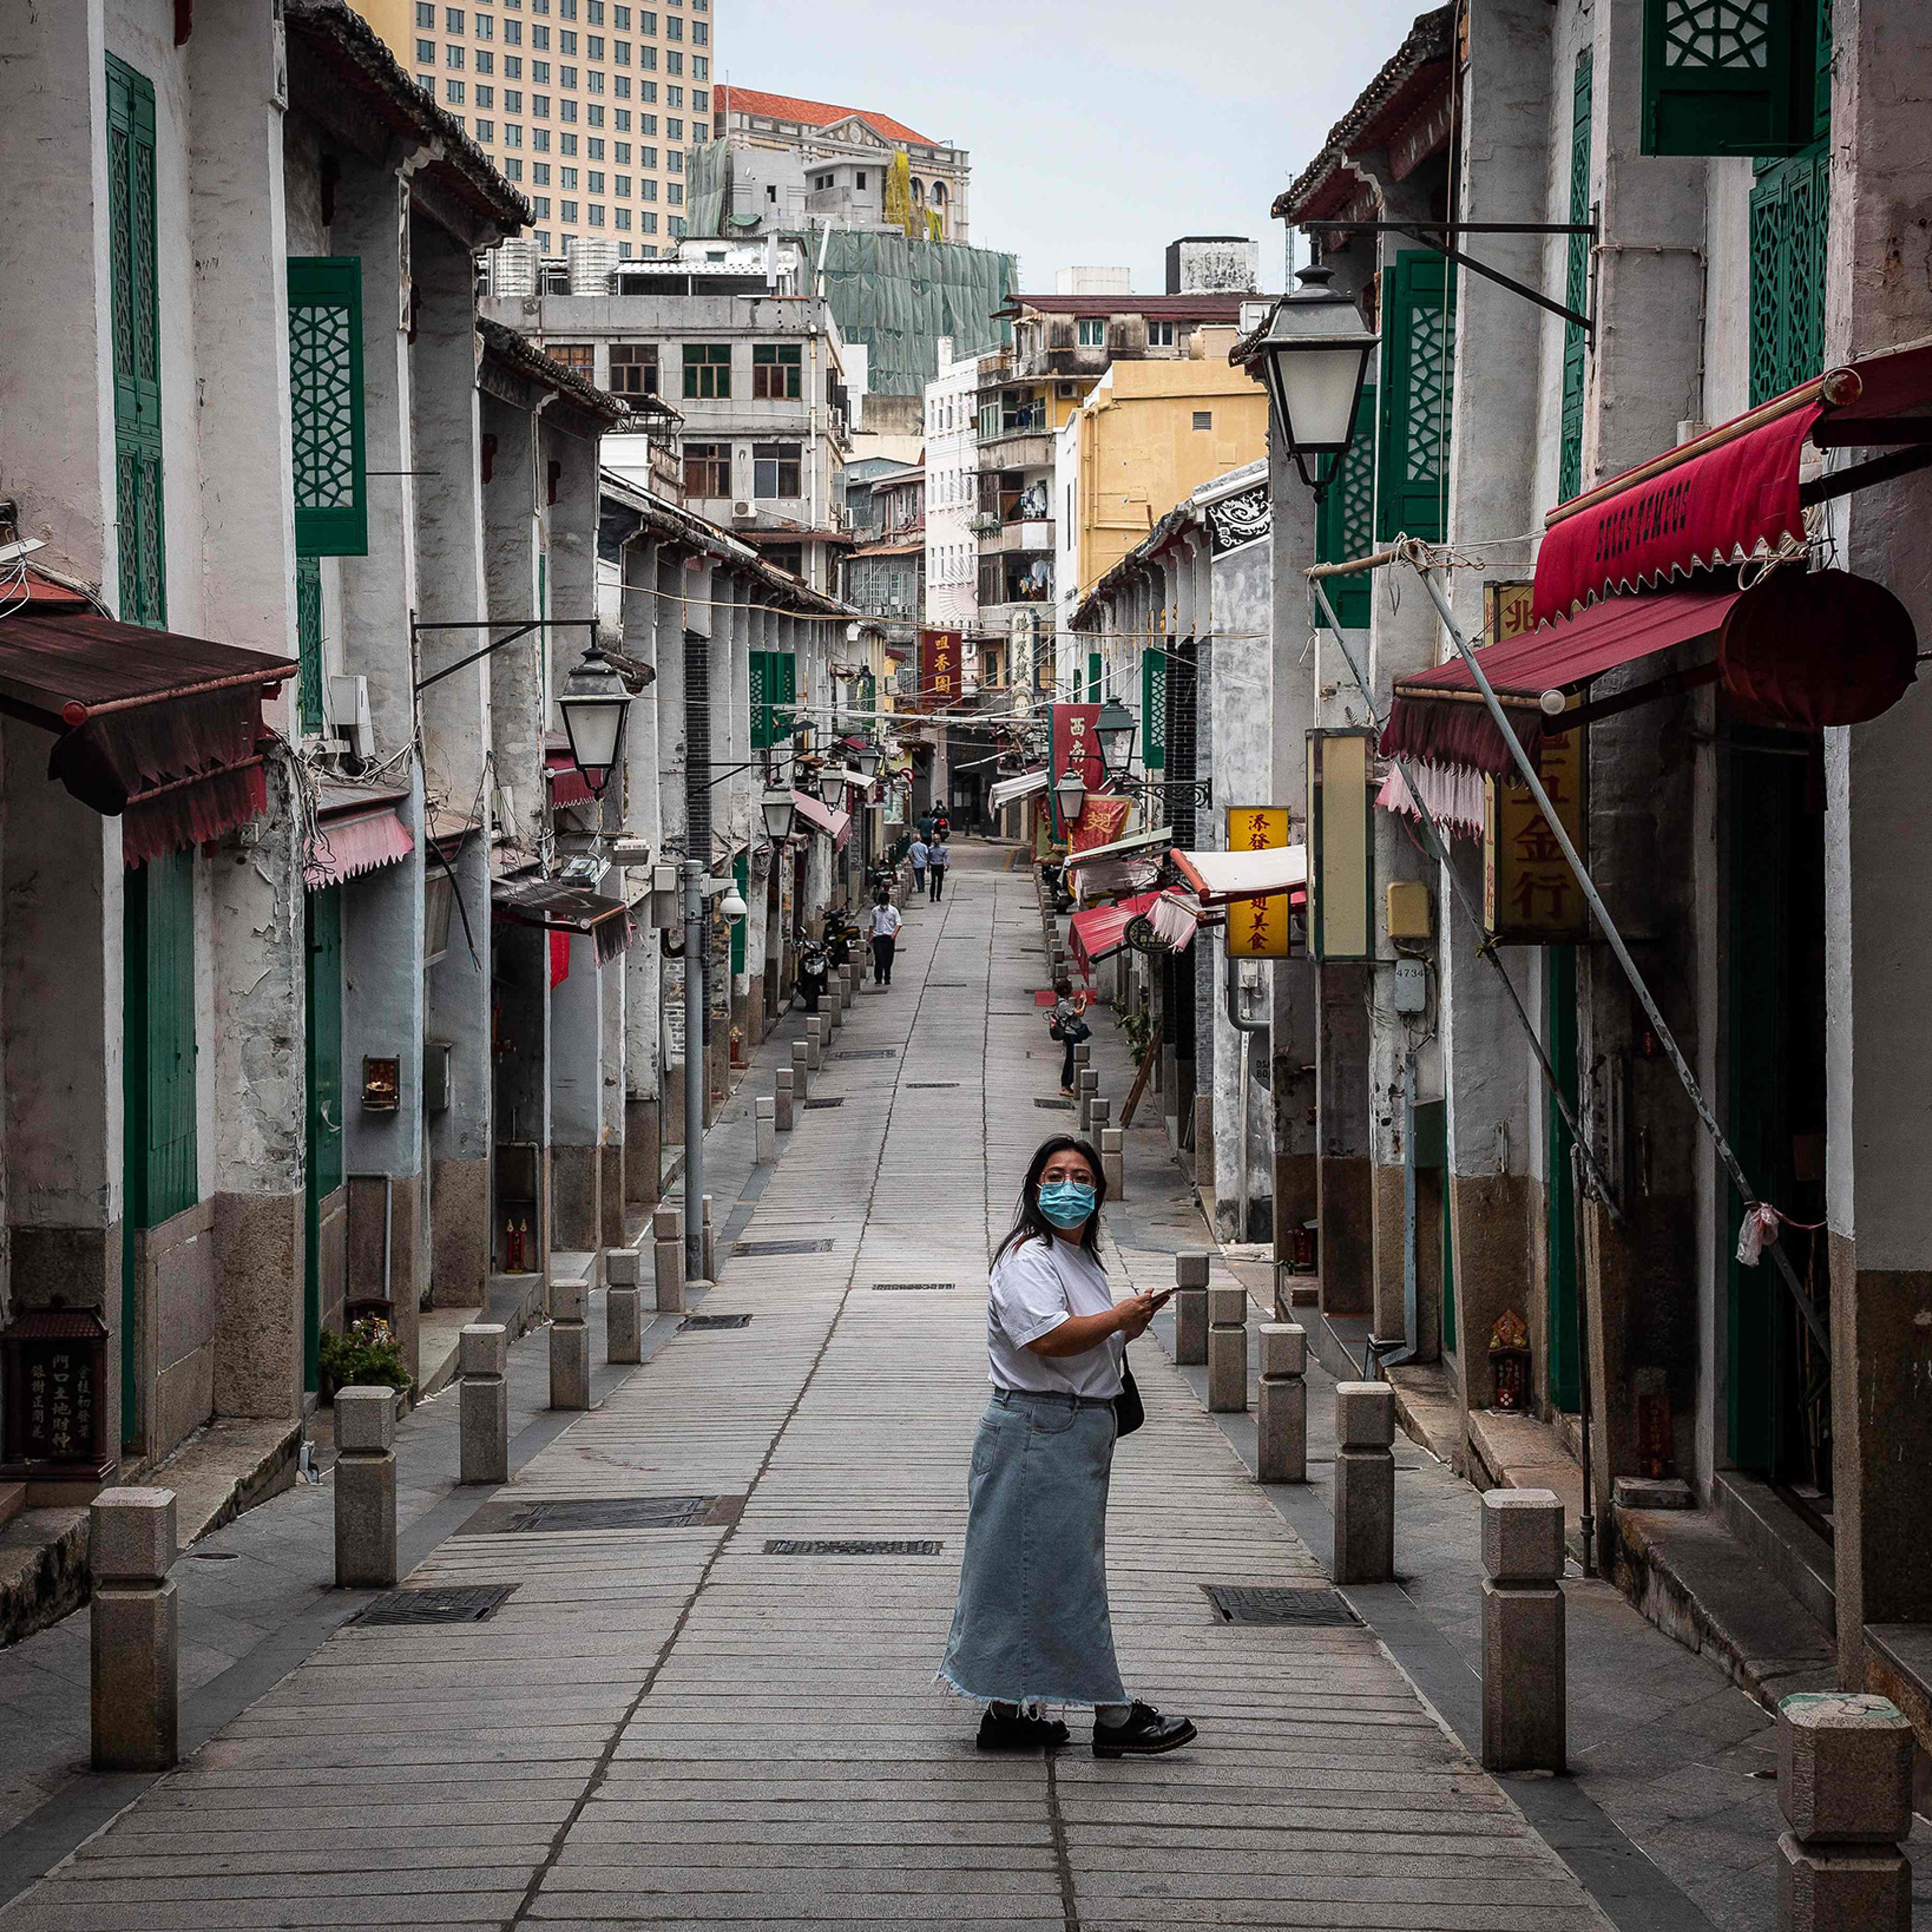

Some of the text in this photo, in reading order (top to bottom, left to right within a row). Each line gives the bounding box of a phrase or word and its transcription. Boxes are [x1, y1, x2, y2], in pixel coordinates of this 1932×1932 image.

[1635, 479, 1691, 547] TEMPOS
[1083, 811, 1113, 834] 翅
[1396, 969, 1424, 977] 4734
